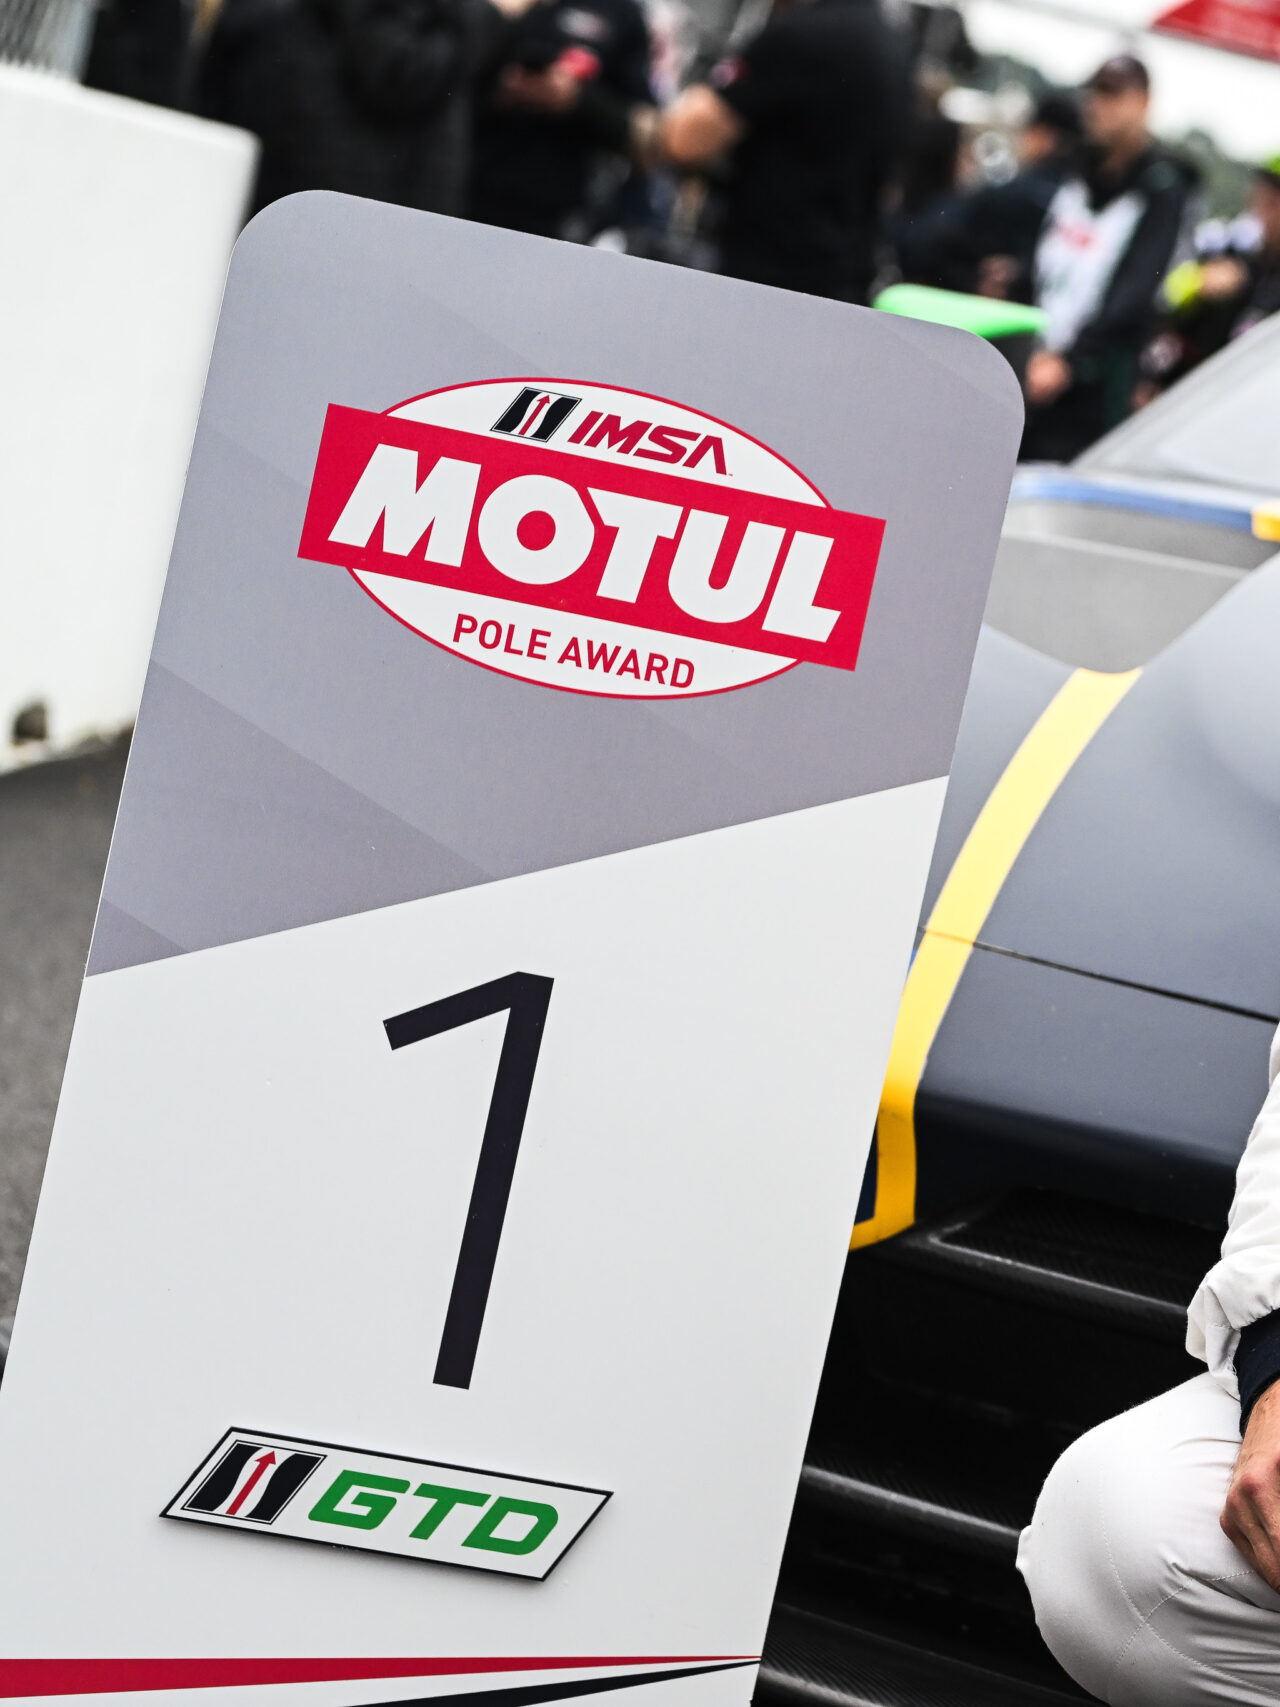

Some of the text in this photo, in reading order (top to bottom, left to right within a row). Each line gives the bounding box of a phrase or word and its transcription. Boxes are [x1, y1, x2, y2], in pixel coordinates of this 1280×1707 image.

[567, 410, 728, 476] IMSA
[328, 443, 842, 643] MOTUL
[452, 613, 695, 688] POLE AWARD
[382, 971, 554, 1390] 1
[308, 1469, 559, 1556] GTD
